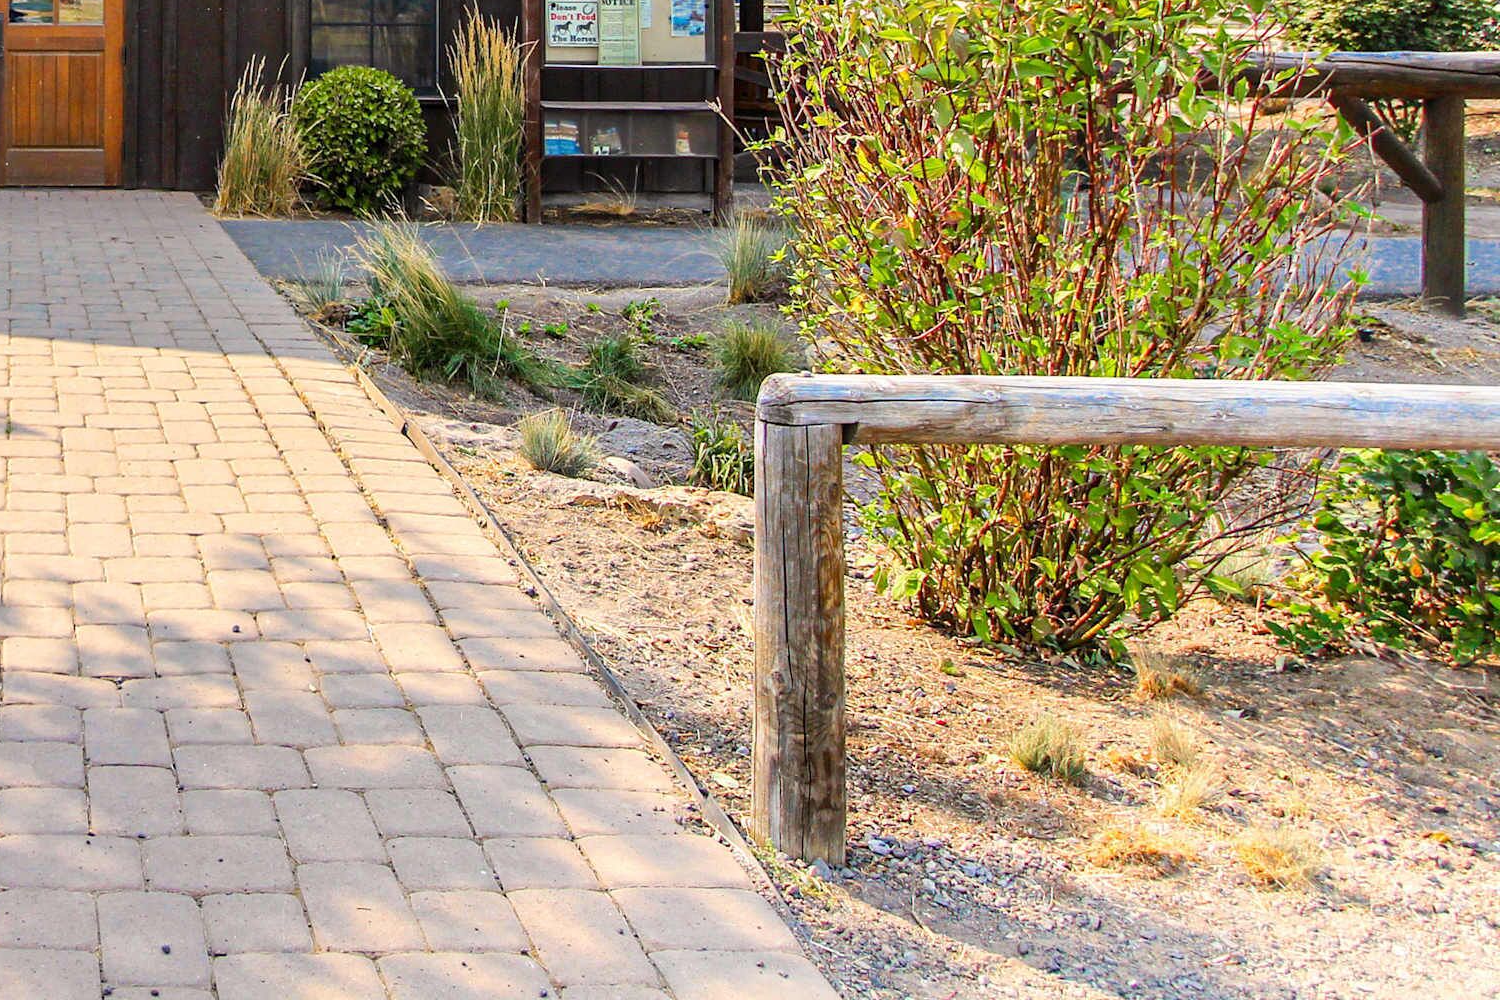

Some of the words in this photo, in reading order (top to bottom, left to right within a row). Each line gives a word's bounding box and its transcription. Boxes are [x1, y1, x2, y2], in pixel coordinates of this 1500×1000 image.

[550, 3, 577, 11] Please
[550, 13, 574, 21] Don't
[577, 13, 596, 21] Feed
